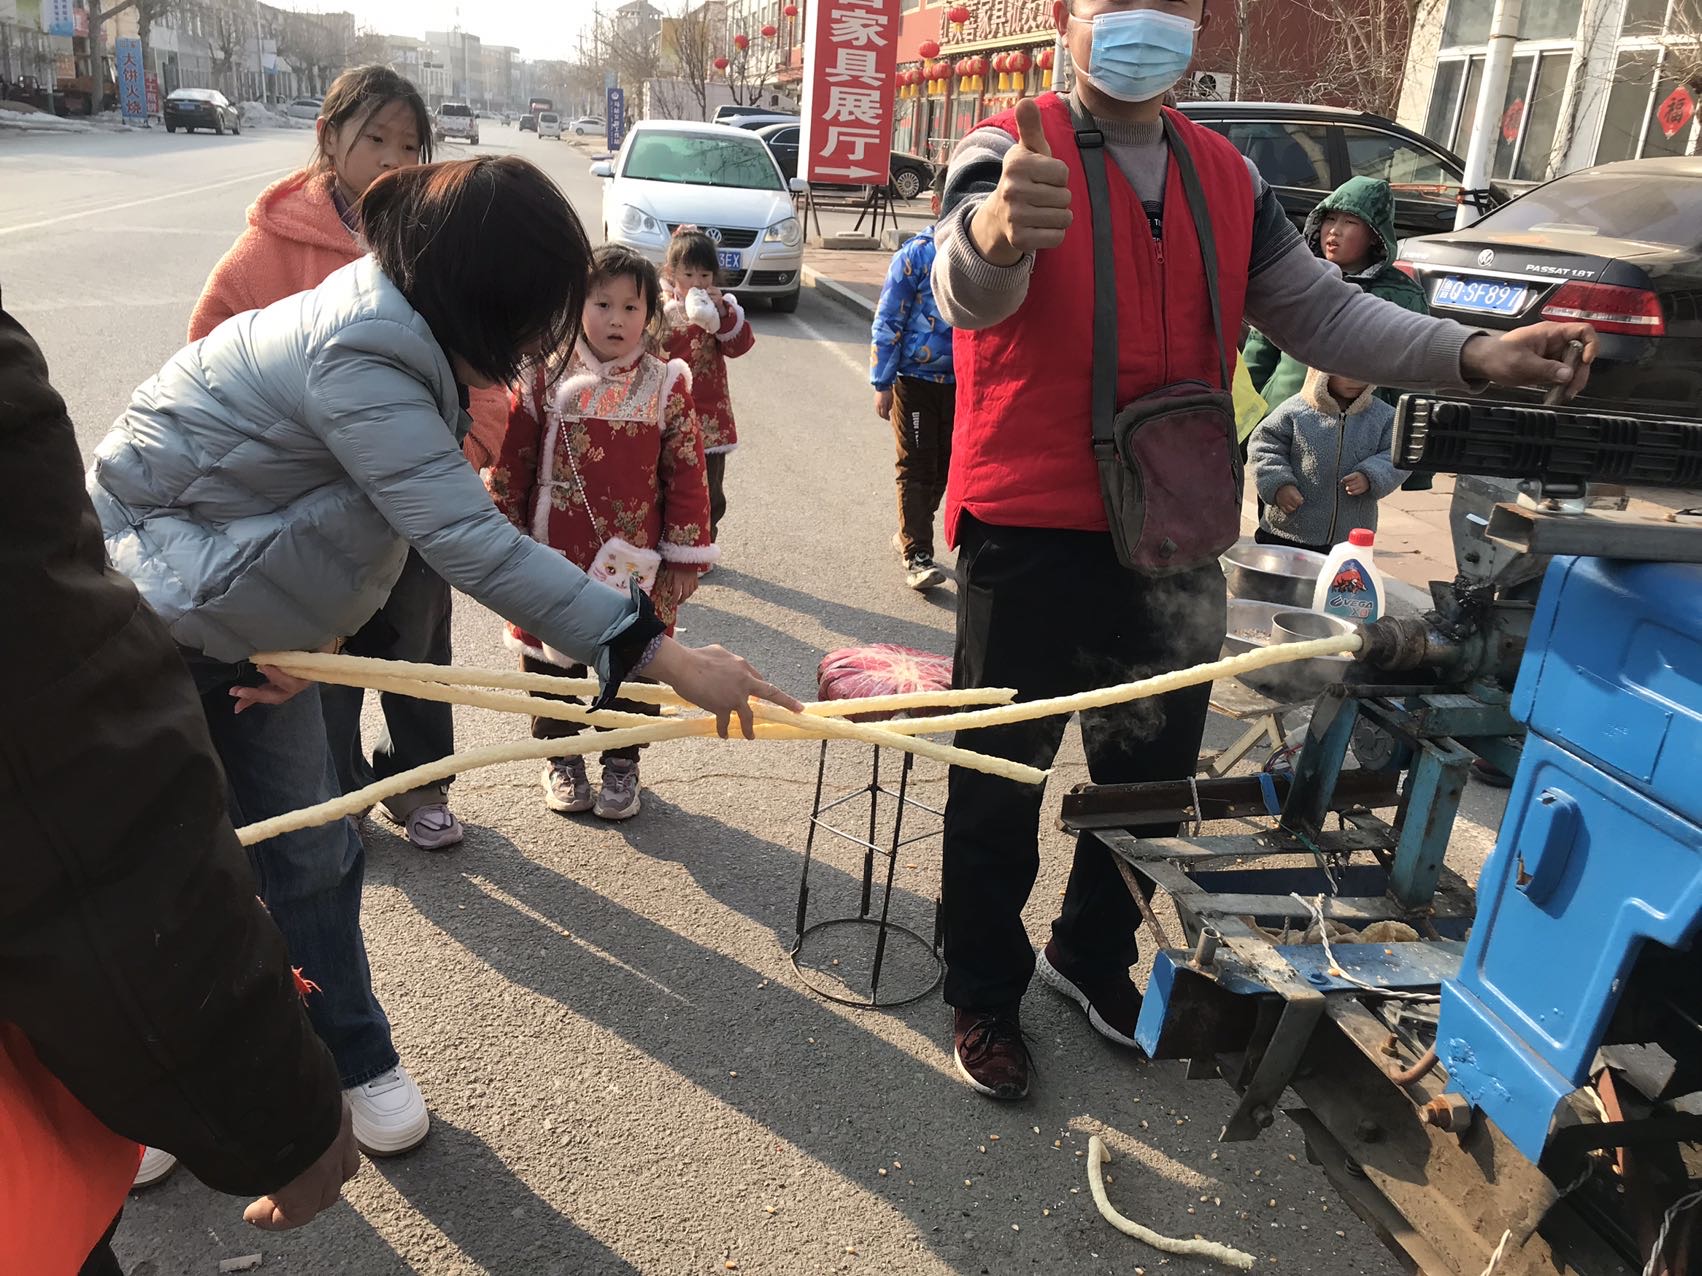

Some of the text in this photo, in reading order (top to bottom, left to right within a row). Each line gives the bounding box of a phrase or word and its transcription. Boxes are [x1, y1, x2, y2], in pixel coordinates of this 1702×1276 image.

[1664, 97, 1686, 124] 福
[1525, 264, 1571, 276] PASSAT
[1343, 599, 1374, 609] VEGA
